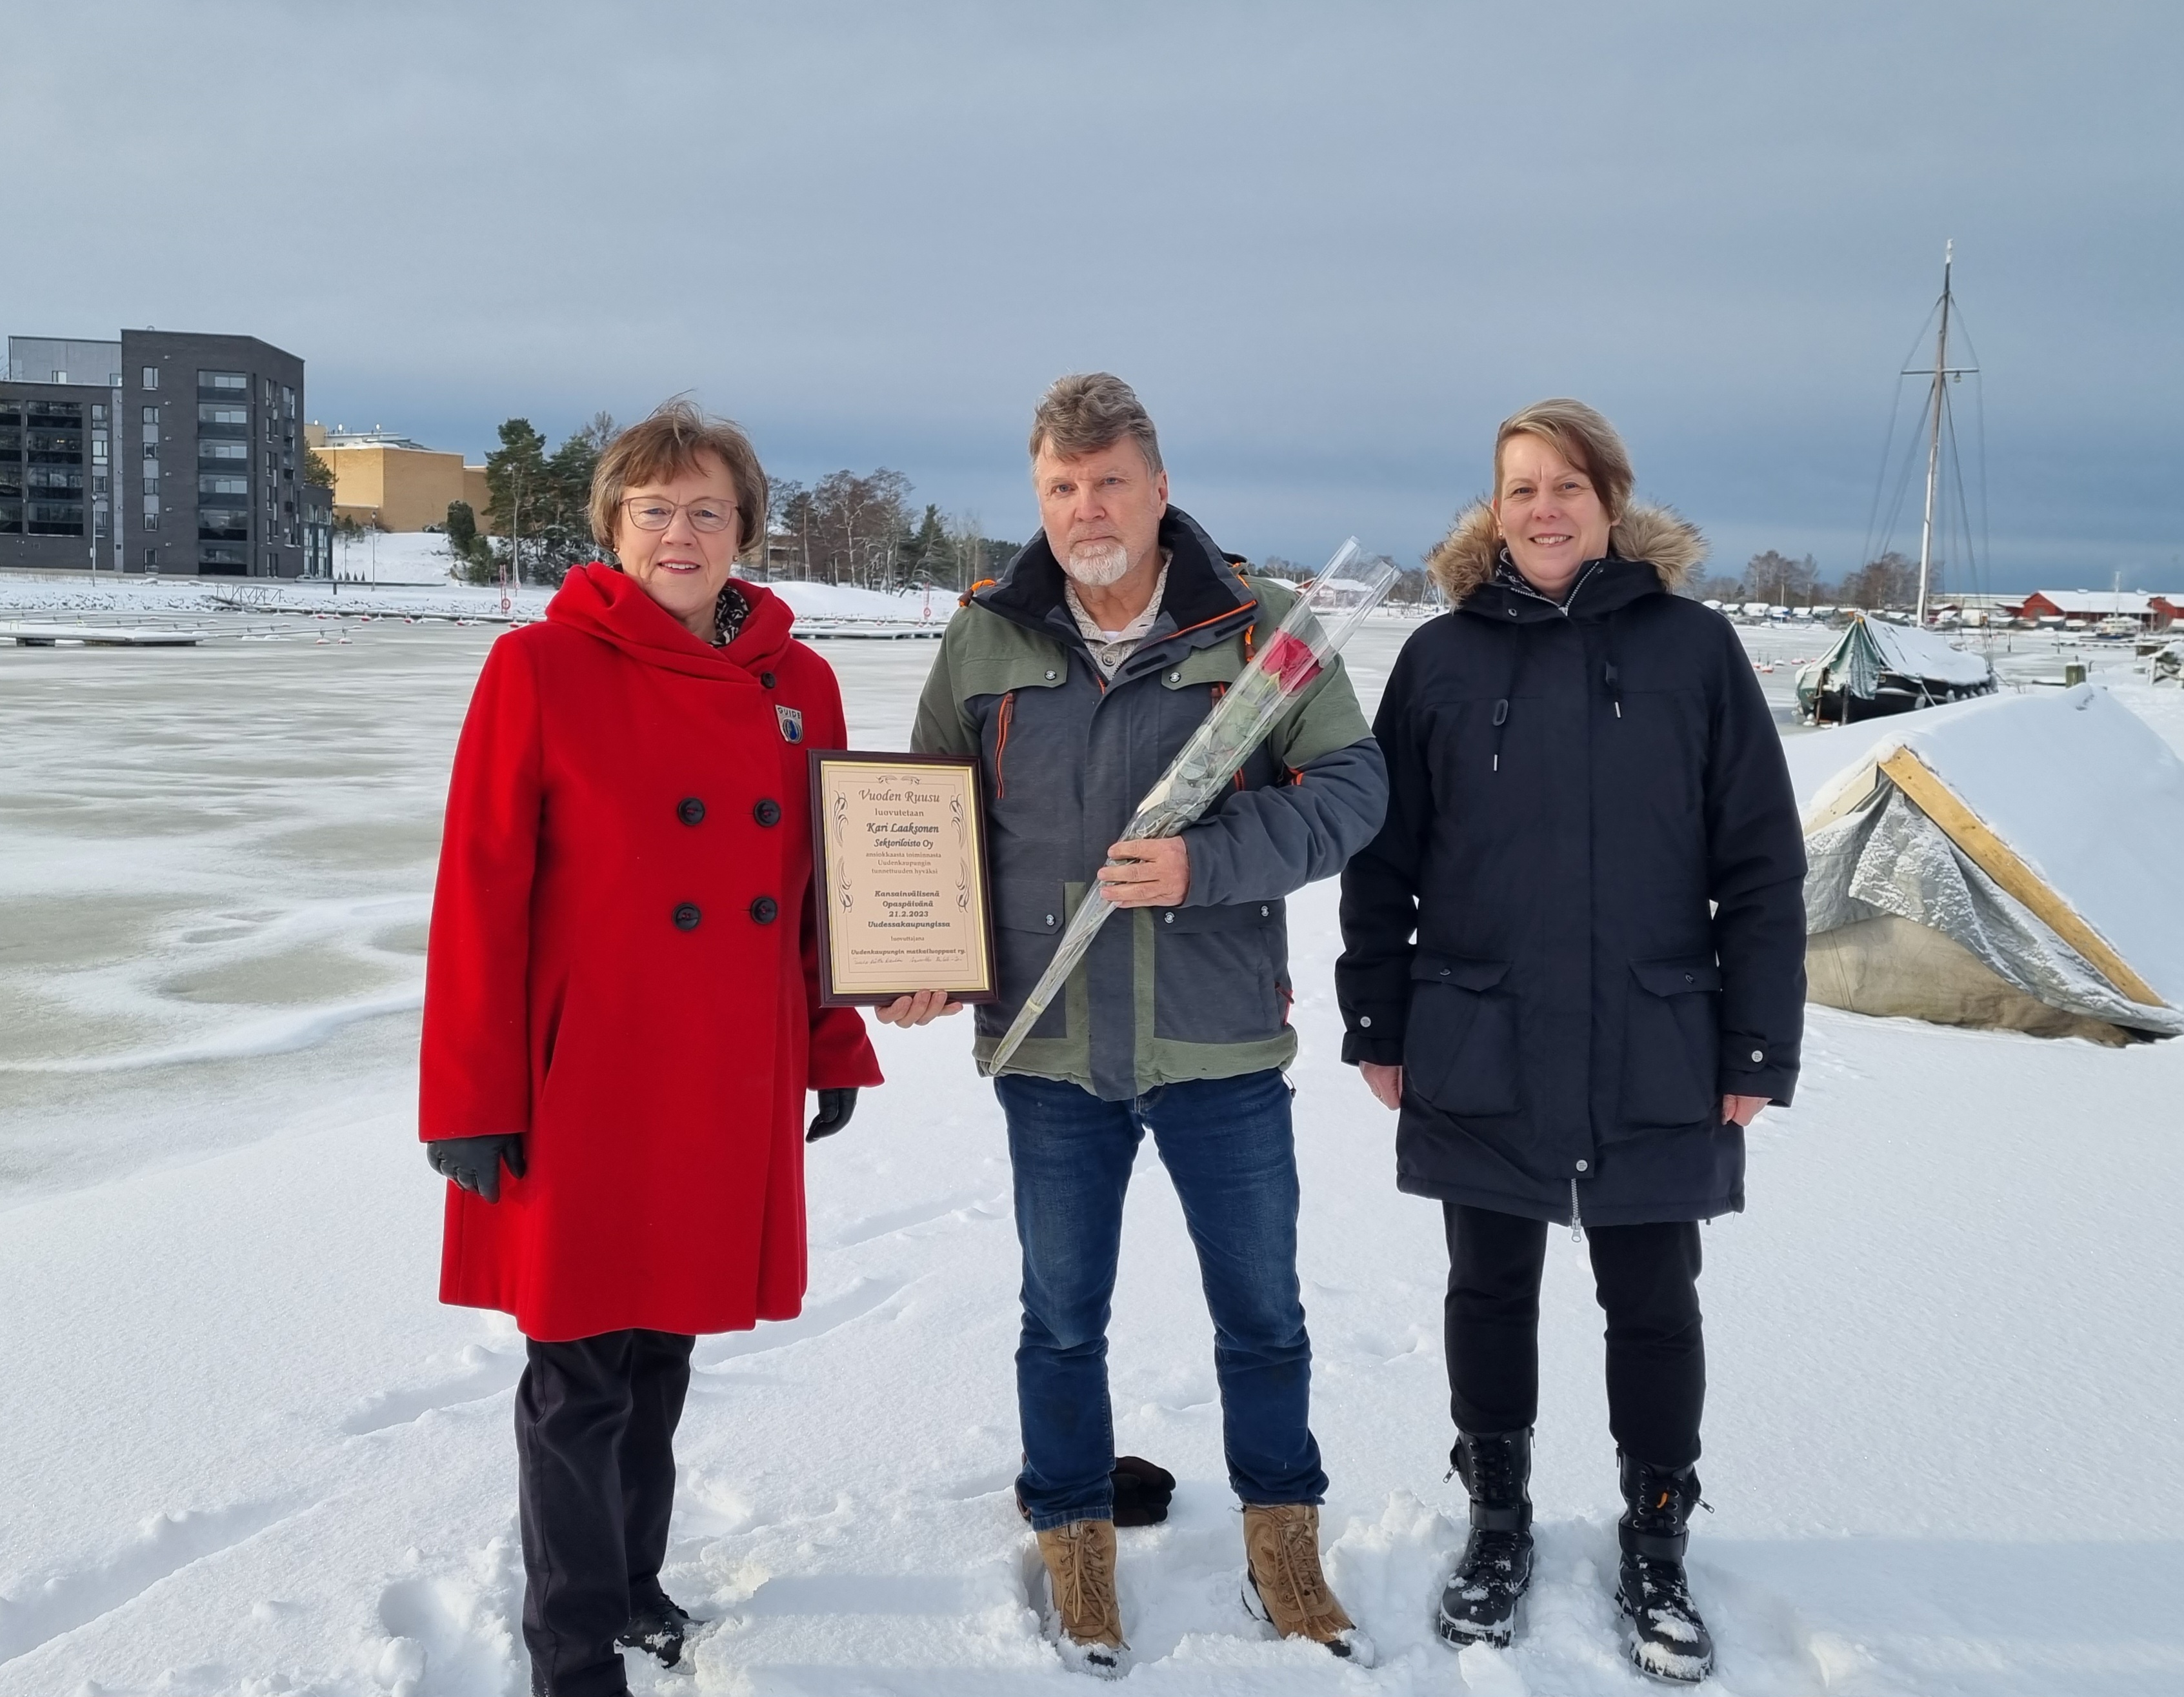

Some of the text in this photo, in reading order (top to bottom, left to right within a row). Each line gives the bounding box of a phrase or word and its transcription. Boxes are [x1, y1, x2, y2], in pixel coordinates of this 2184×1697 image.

[777, 707, 800, 719] GUIDE
[859, 788, 940, 804] Vuoden Ruusu
[874, 808, 924, 816] luovutetaan
[867, 822, 939, 835] Kari Laaksonen
[874, 838, 934, 850] Sektoriloisto Oy
